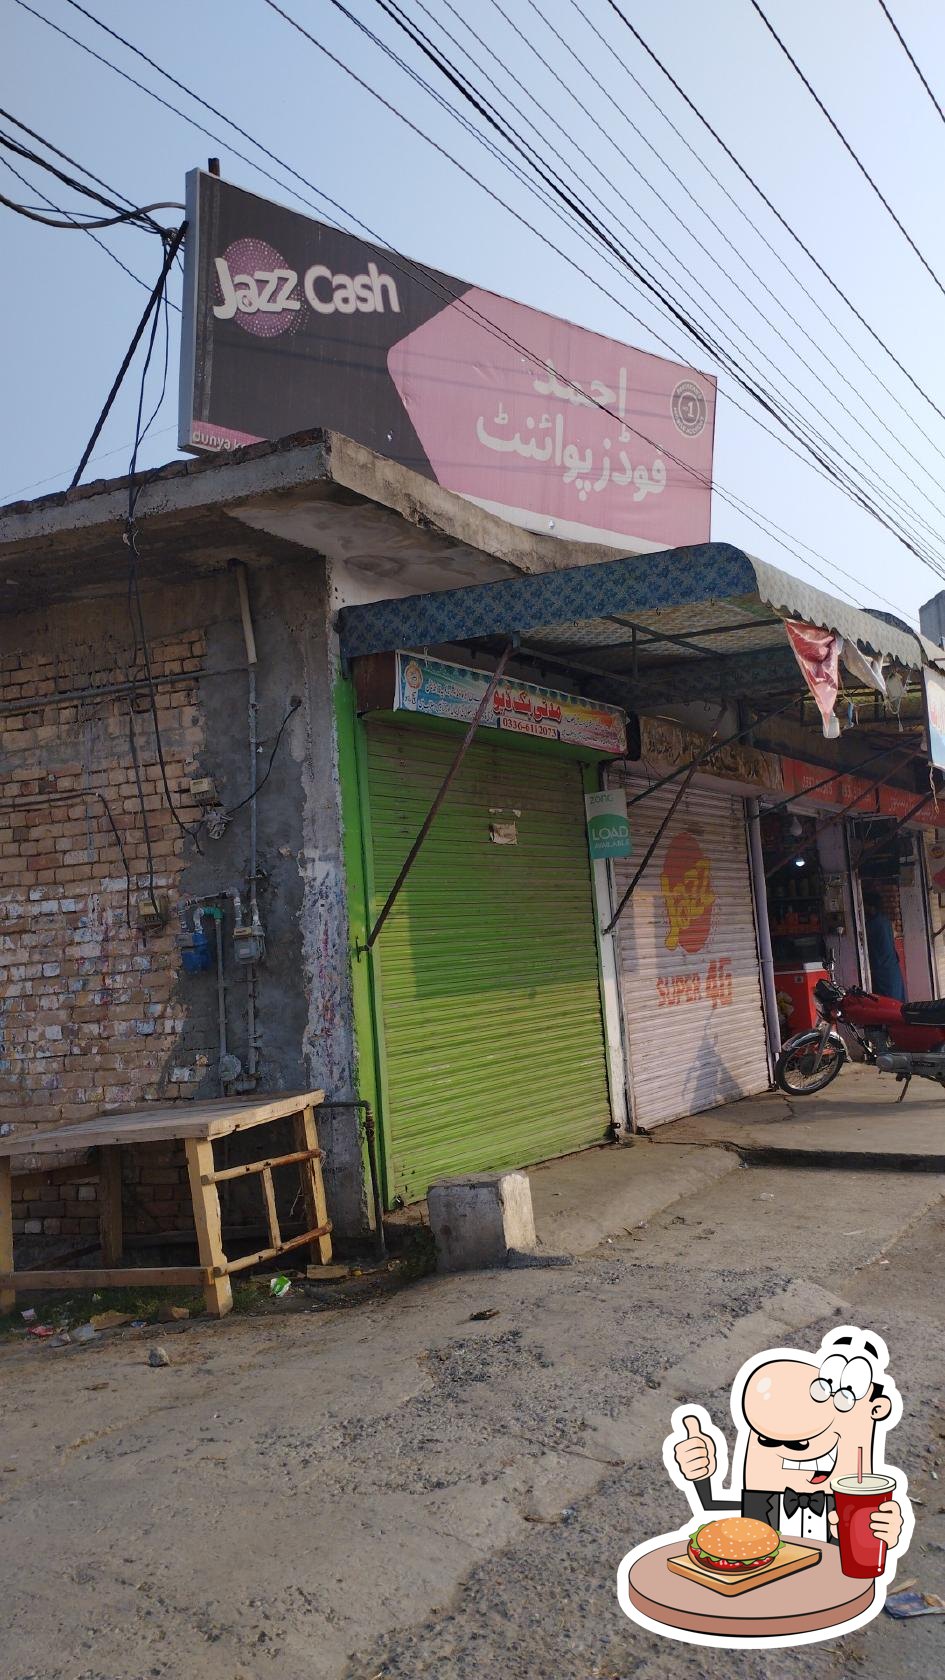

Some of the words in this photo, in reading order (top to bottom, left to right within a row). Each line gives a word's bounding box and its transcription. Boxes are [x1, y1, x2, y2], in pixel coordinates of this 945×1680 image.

[212, 257, 302, 320] Jazz
[304, 262, 401, 315] Cash
[532, 357, 628, 420] احمد
[192, 430, 231, 449] dunya
[591, 826, 629, 841] LOAD
